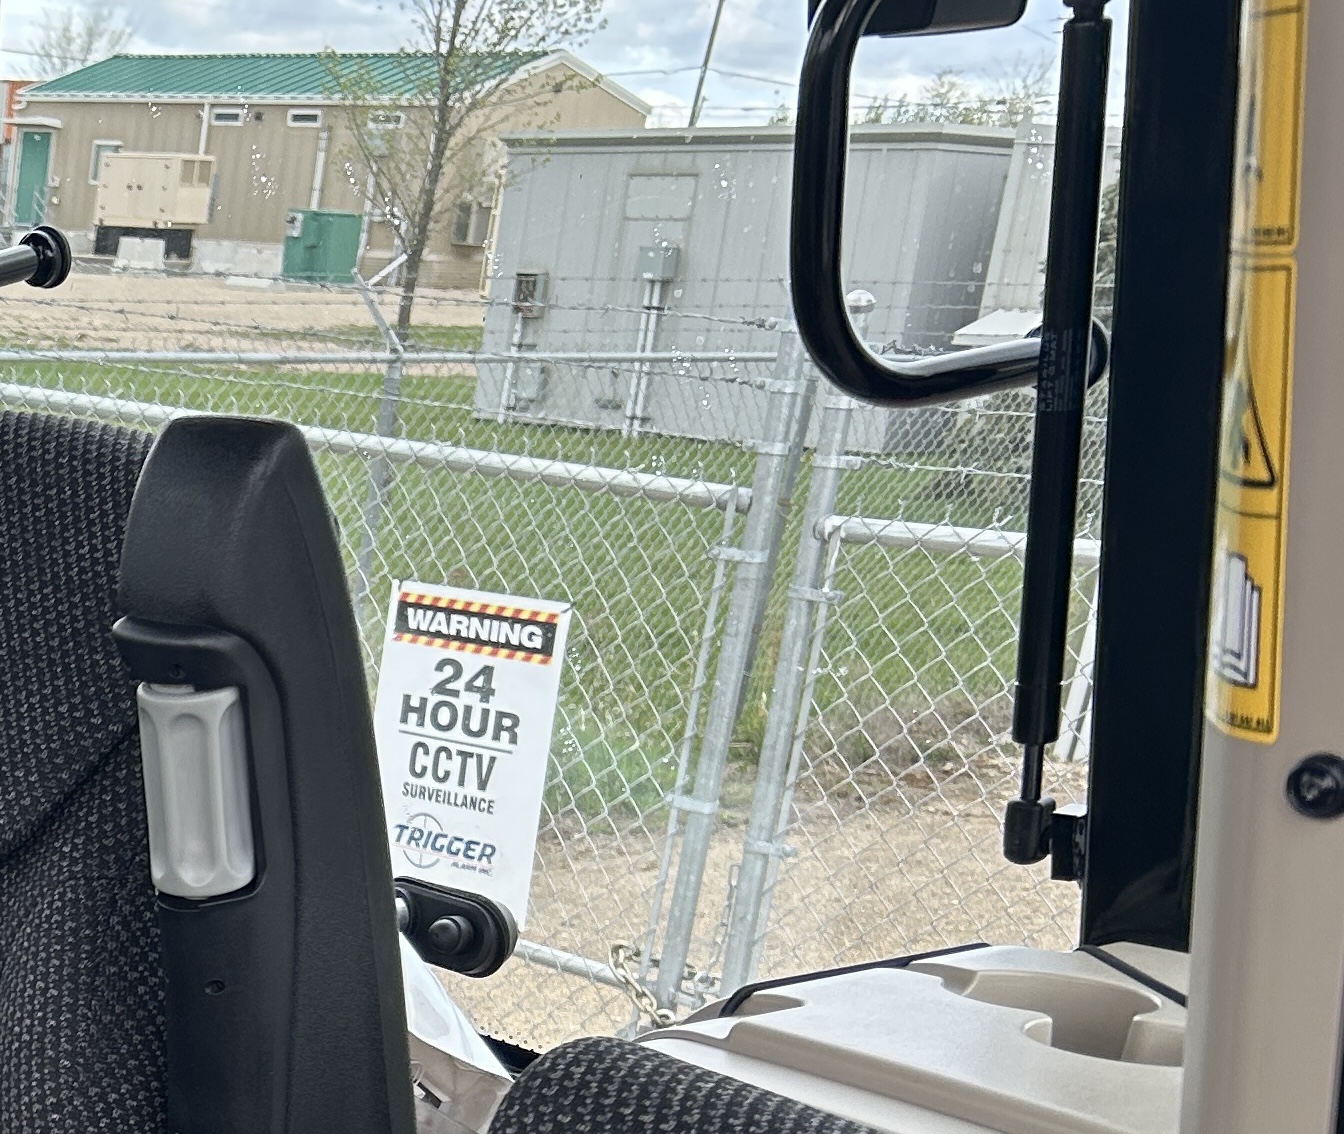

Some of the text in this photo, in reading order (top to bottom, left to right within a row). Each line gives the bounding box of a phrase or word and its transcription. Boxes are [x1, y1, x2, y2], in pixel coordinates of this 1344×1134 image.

[407, 607, 543, 649] WARNING
[431, 657, 495, 703] 24
[399, 693, 520, 745] HOUR
[409, 741, 497, 792] CCTV
[401, 781, 495, 815] SURVEILLANCE
[393, 823, 497, 865] TRIGGER
